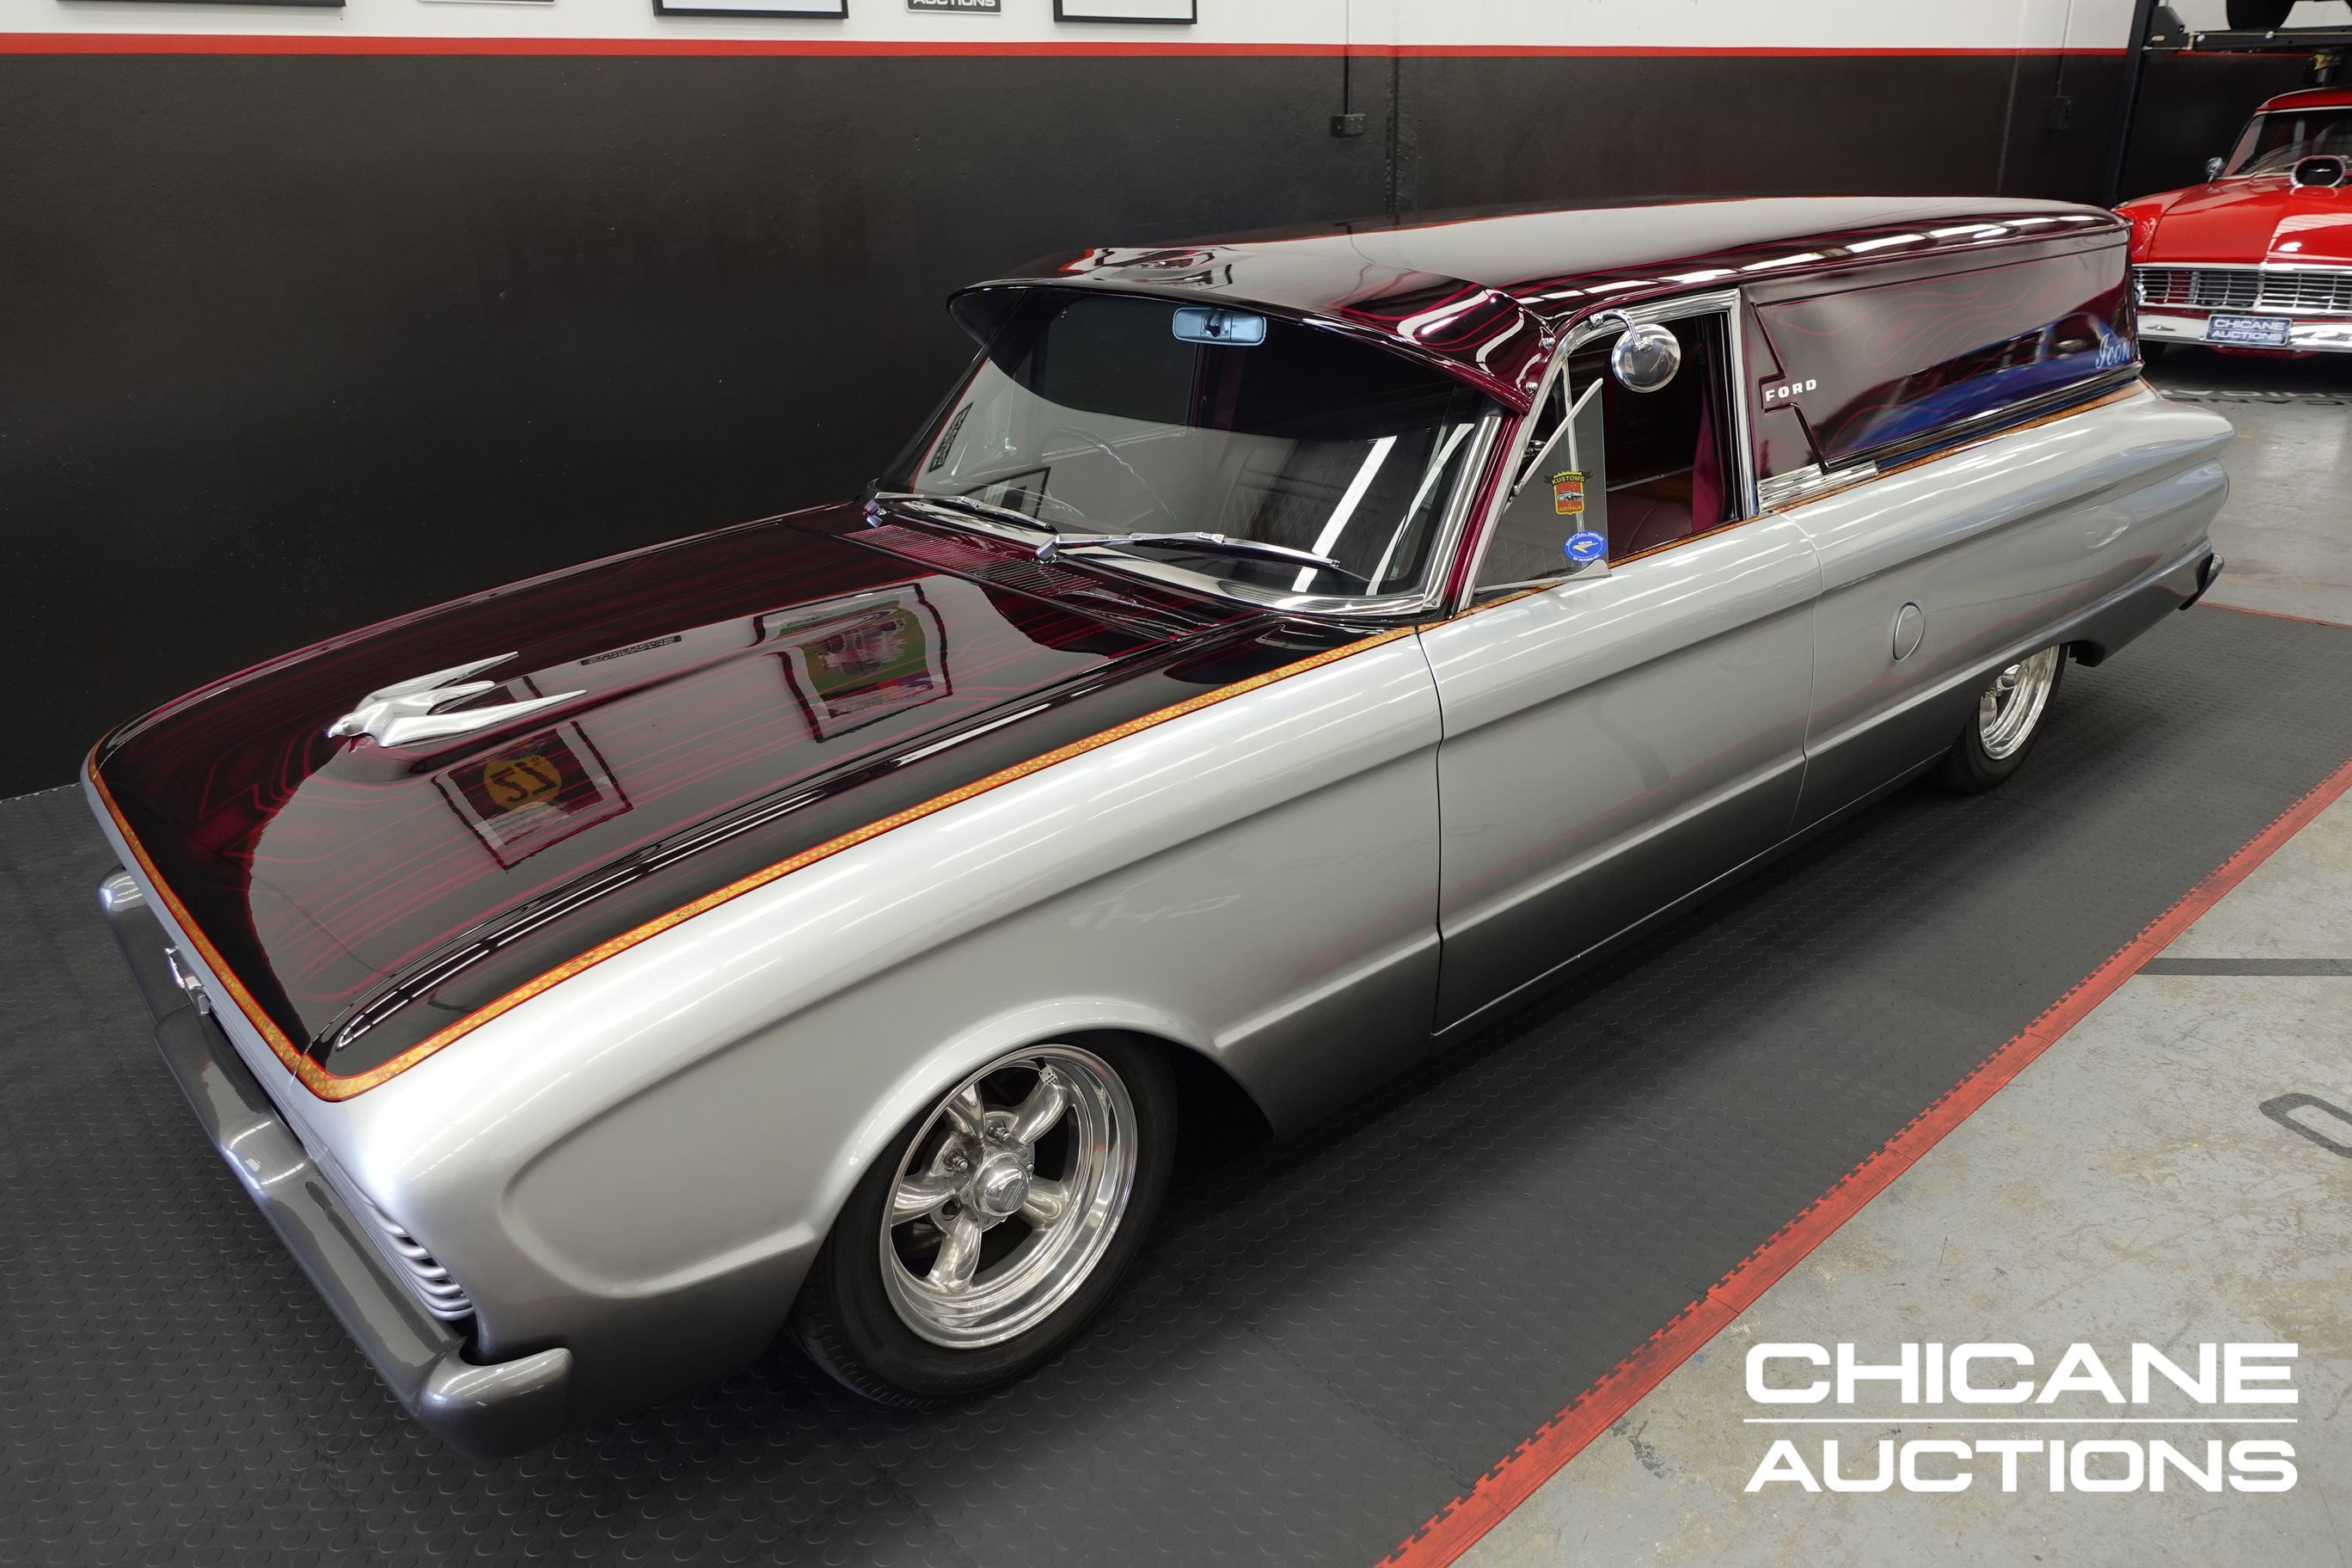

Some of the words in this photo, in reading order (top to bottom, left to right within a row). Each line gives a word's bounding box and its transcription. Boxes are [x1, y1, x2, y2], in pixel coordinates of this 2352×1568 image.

[2214, 319, 2286, 331] CHICANE
[2211, 329, 2283, 341] AUCTIONS
[1765, 379, 1817, 402] FORD
[1552, 475, 1585, 485] KUSTOMS
